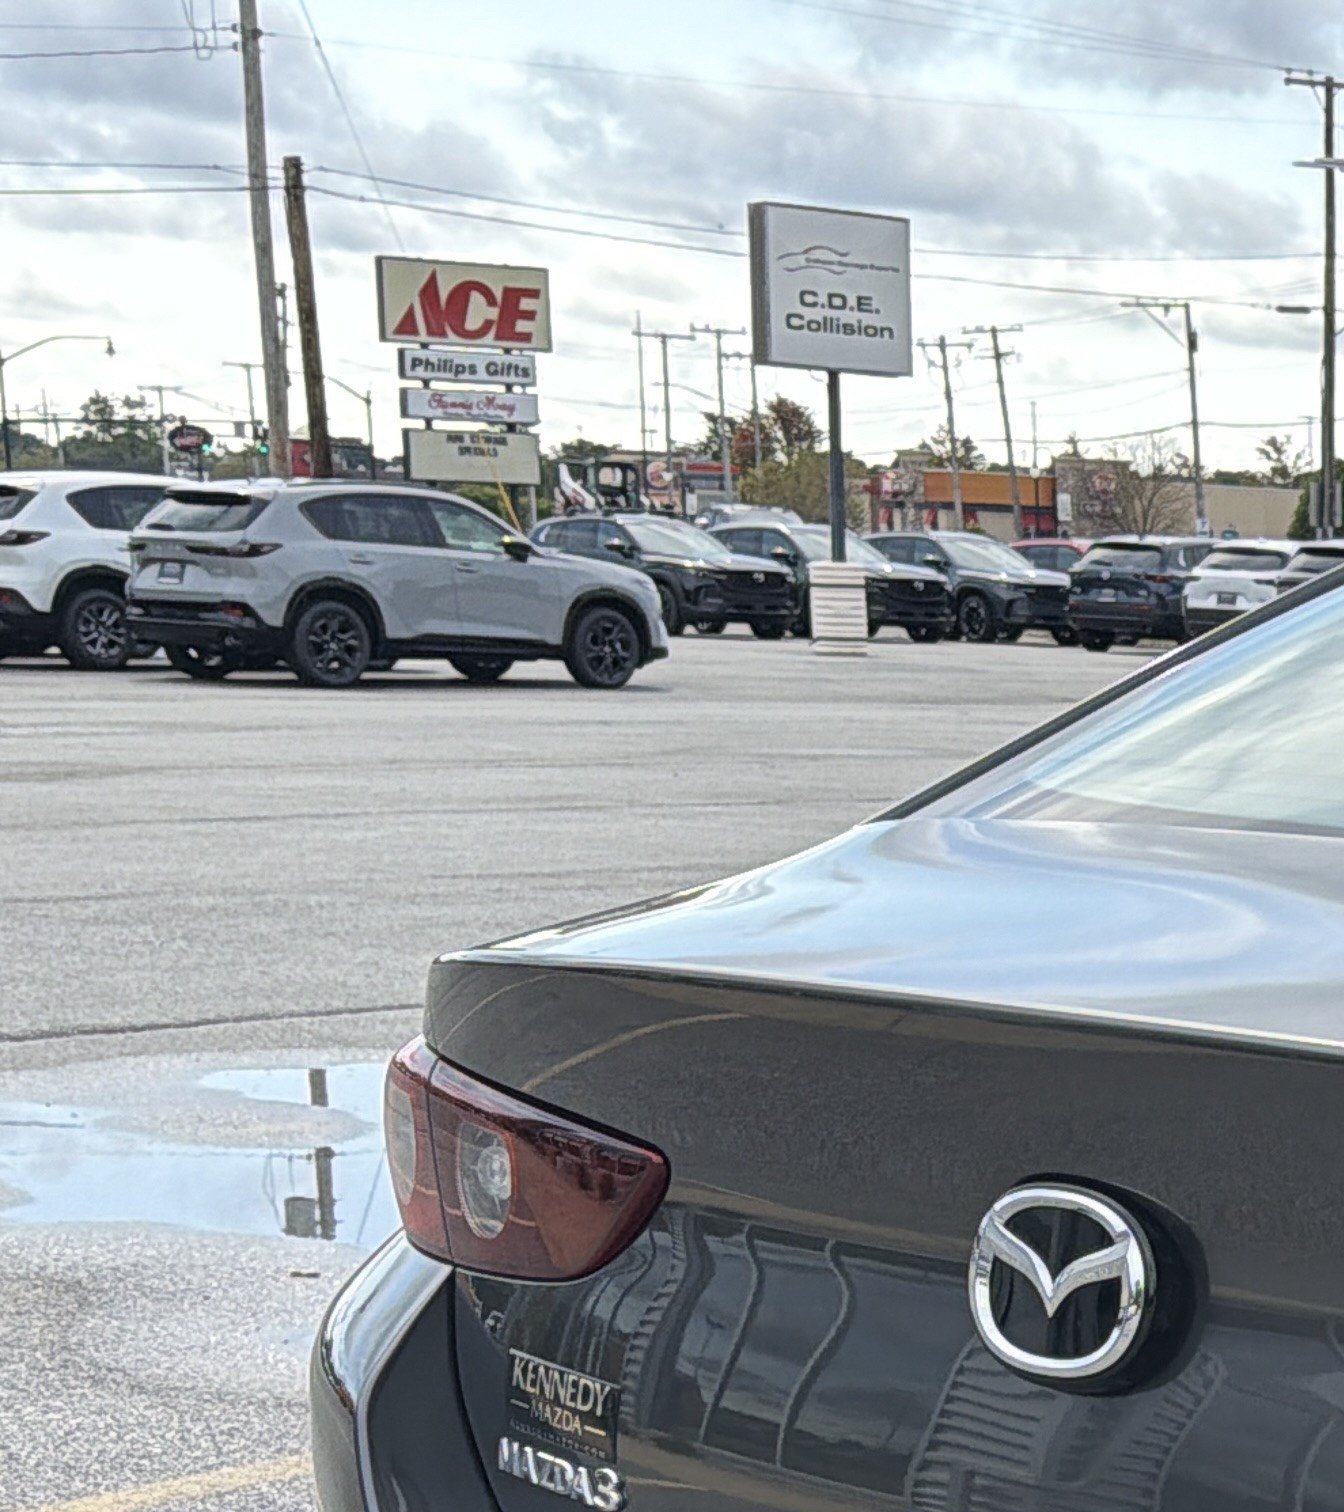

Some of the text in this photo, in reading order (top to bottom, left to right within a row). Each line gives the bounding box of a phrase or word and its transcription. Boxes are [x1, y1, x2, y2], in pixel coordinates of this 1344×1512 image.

[392, 268, 541, 343] ACE
[799, 289, 881, 315] C.D.E.
[785, 313, 895, 341] Collision
[409, 356, 532, 380] Philips Gifts
[510, 1355, 611, 1417] KENNEDY
[529, 1399, 583, 1437] MAZDA
[498, 1436, 624, 1512] MAZDA3
